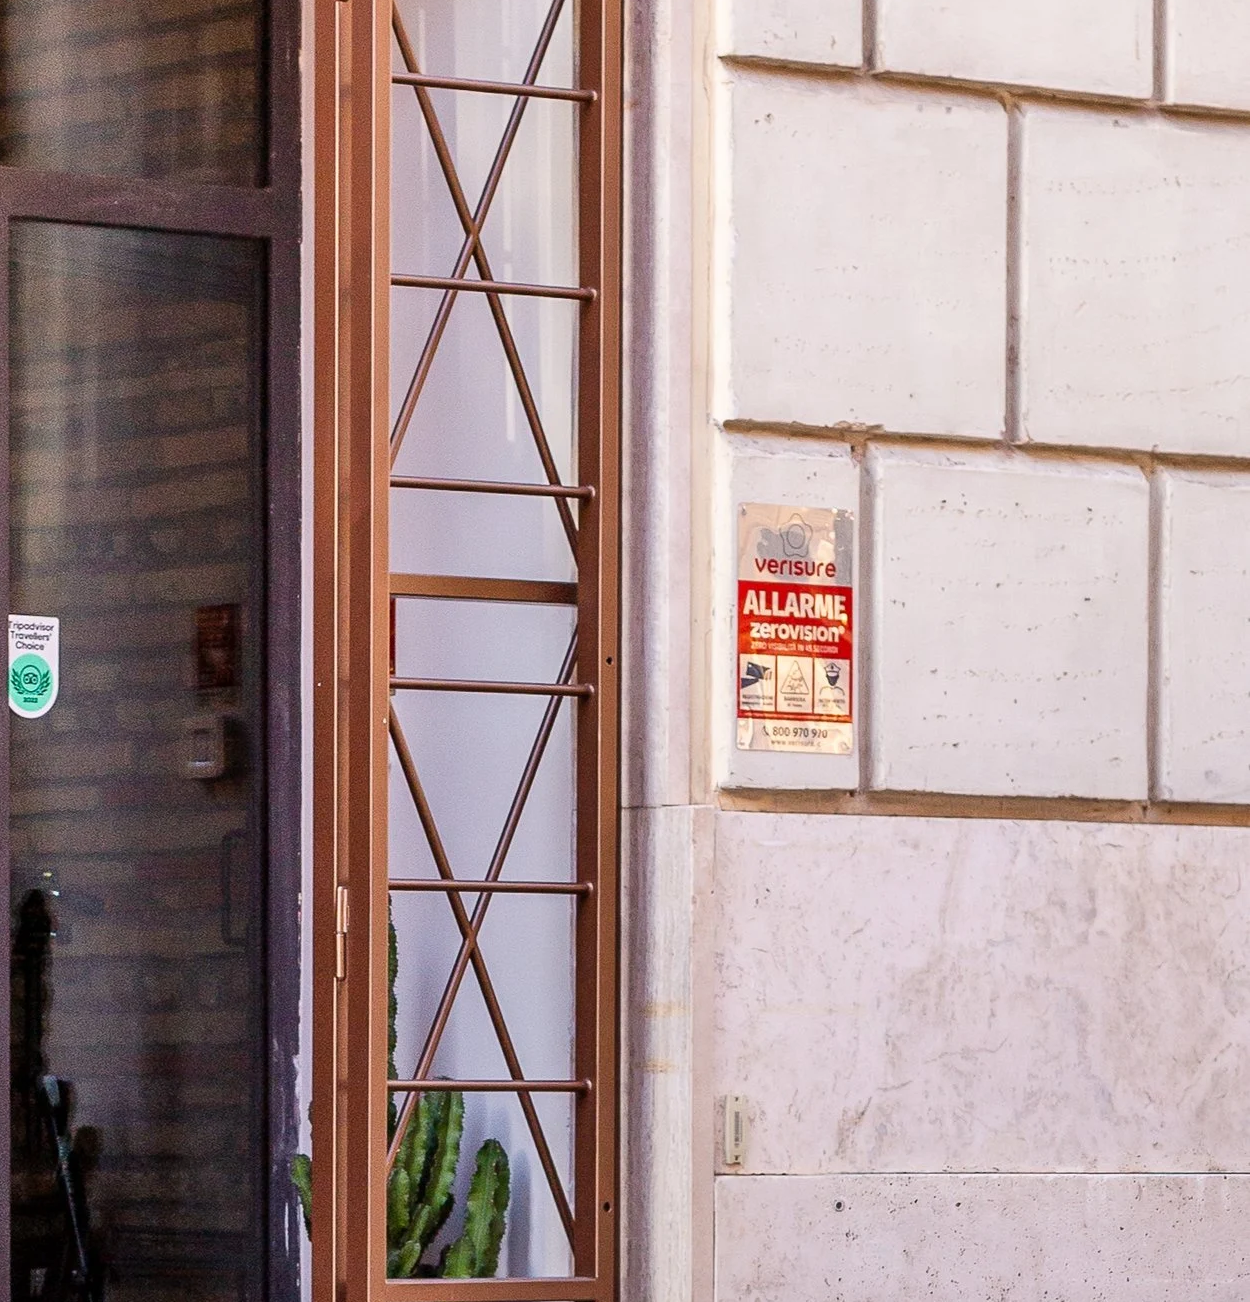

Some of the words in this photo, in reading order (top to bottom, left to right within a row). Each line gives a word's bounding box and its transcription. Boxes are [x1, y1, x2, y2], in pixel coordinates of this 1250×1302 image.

[755, 558, 836, 577] verisure
[743, 590, 846, 620] ALLARME
[15, 641, 44, 651] Choice
[772, 726, 790, 736] 800
[792, 727, 809, 737] 970
